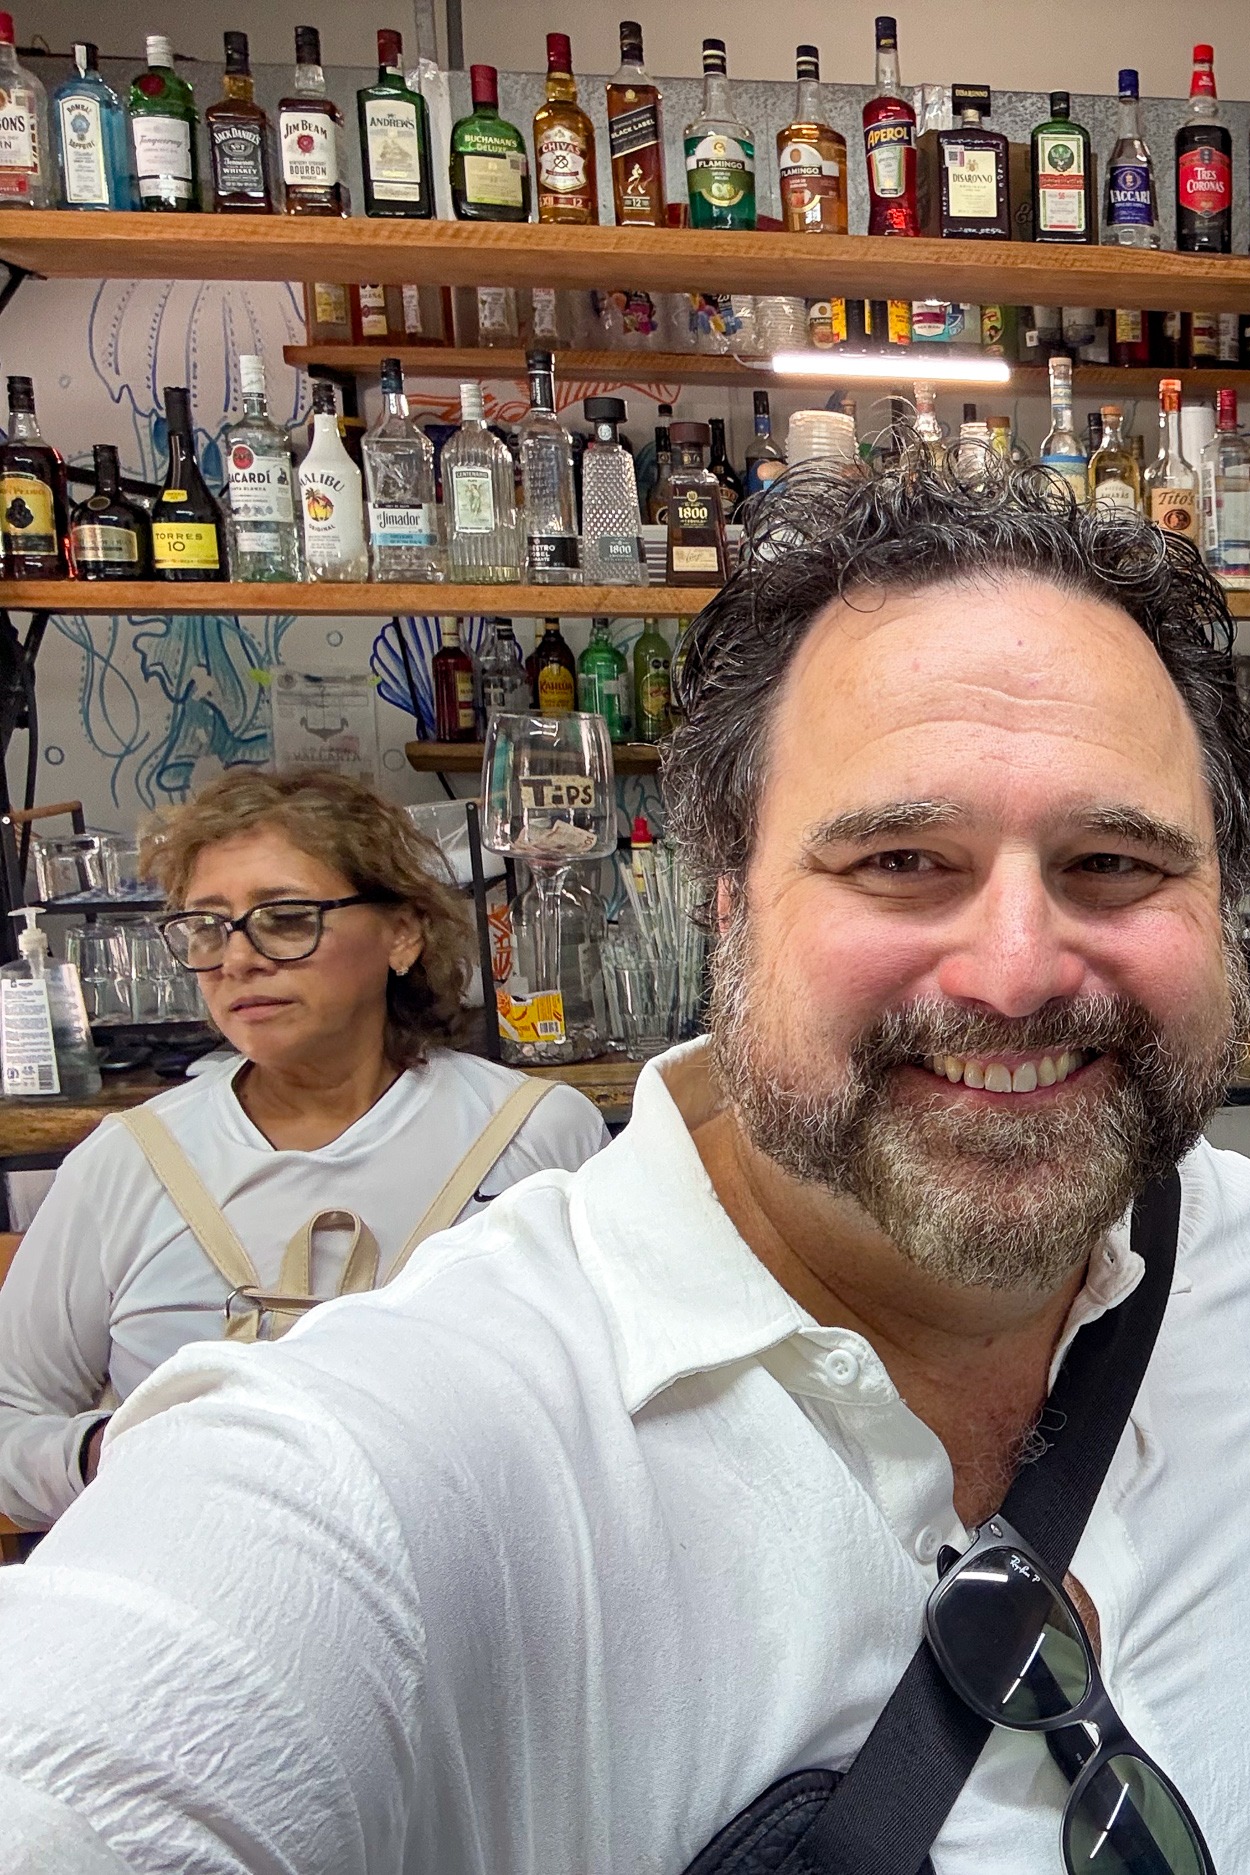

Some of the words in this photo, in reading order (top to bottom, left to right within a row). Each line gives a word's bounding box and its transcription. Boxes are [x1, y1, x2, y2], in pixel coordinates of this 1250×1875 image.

[0, 115, 25, 132] ON'S
[284, 123, 300, 139] JIM
[301, 119, 328, 140] BEAM
[611, 127, 633, 139] BLACK
[634, 118, 655, 131] LABEL
[214, 131, 231, 145] JACK
[464, 134, 518, 148] BUCHANAN'S
[867, 126, 909, 146] APEROL
[541, 142, 581, 154] CHIVAS
[289, 165, 327, 176] BOURBON
[698, 160, 743, 170] FLAMINGO
[781, 167, 820, 177] FLAMINGO
[1194, 167, 1217, 180] TRES
[952, 173, 993, 184] DISARONNO
[1186, 180, 1225, 194] CORONAS
[456, 471, 488, 479] CENTENARIO
[299, 472, 345, 492] MALIBU
[1159, 491, 1195, 506] Tito's
[678, 507, 708, 519] 1800
[380, 511, 420, 528] Jimador
[309, 524, 336, 532] ORIGINAL
[156, 532, 203, 540] TORRES
[168, 541, 185, 552] 10
[609, 545, 632, 555] 1800
